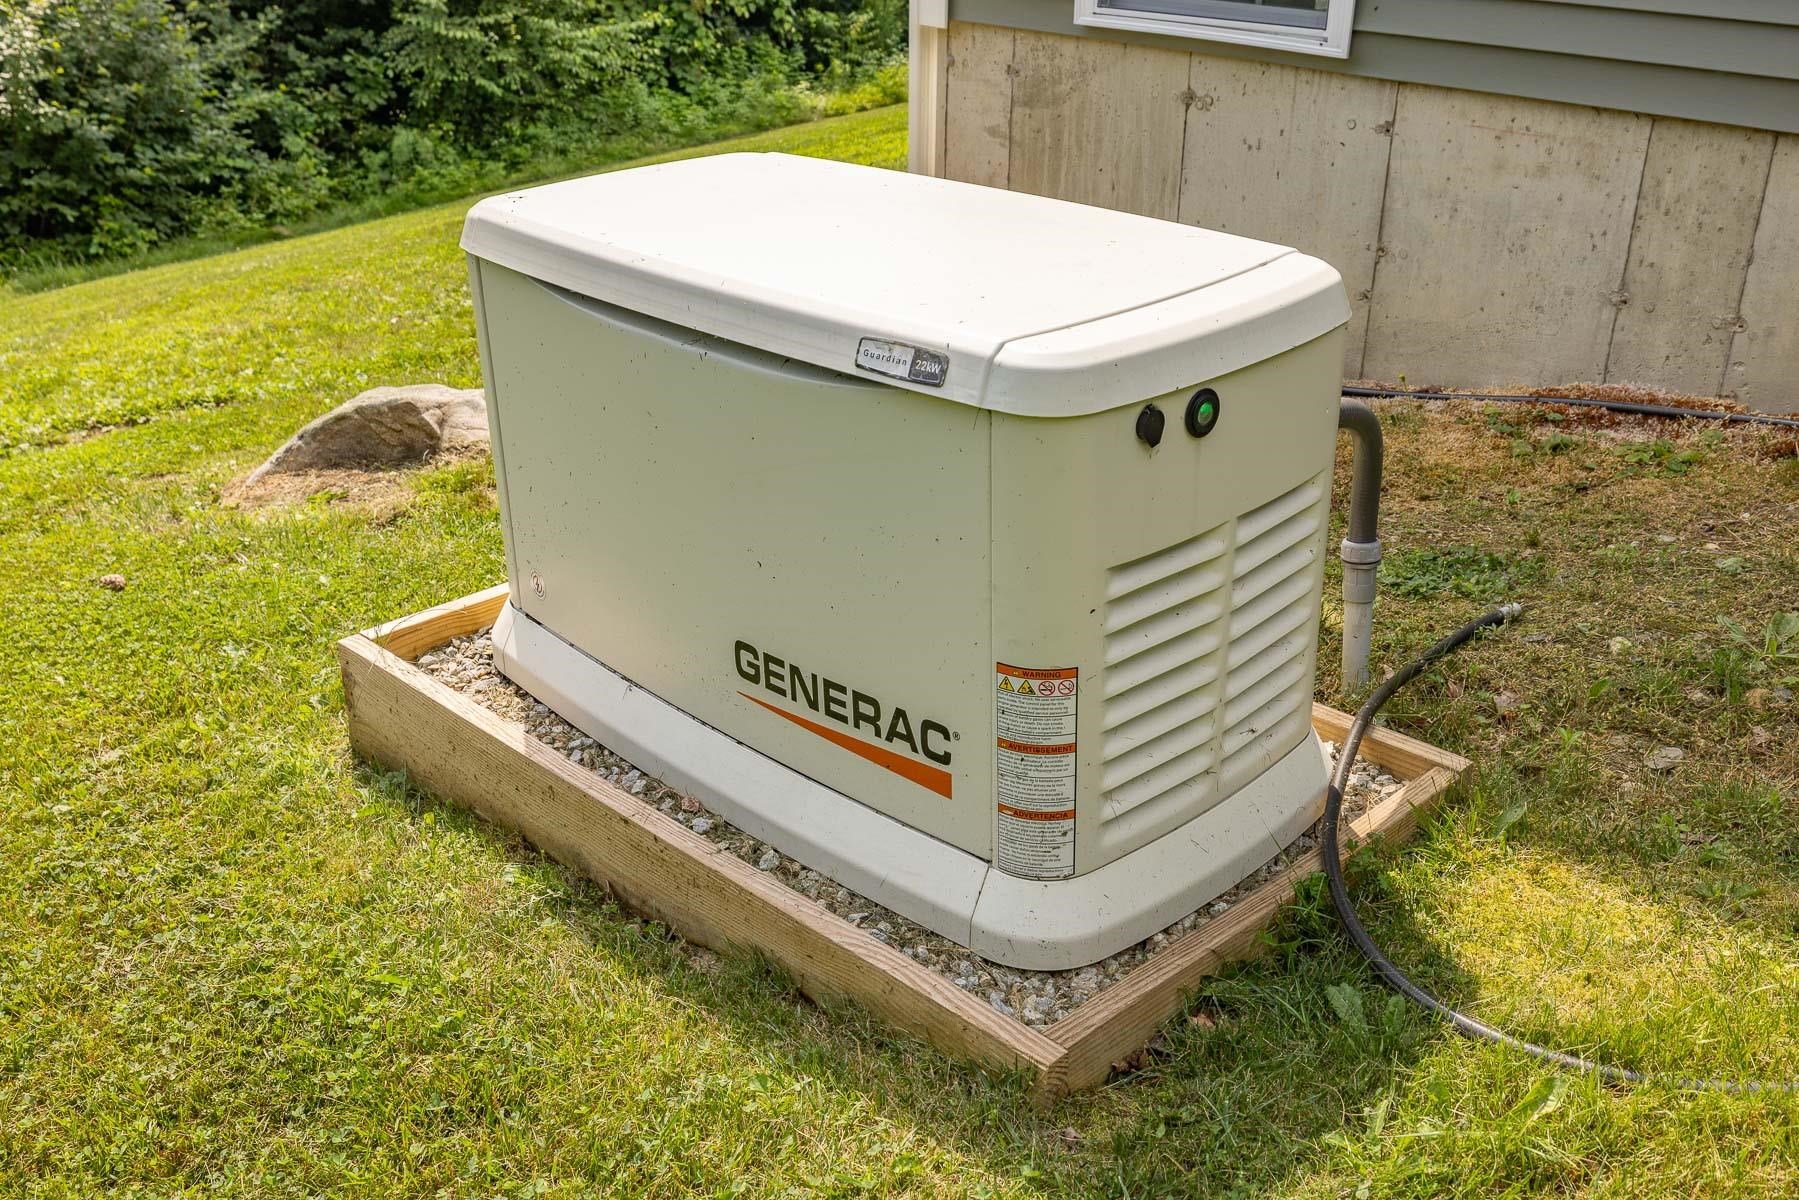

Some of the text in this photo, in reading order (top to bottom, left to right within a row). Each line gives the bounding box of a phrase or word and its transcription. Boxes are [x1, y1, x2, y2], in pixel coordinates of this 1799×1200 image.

[863, 349, 942, 374] Guardian 22kW
[1022, 671, 1062, 679] WARNING
[1013, 810, 1069, 819] ADVERTENCIA
